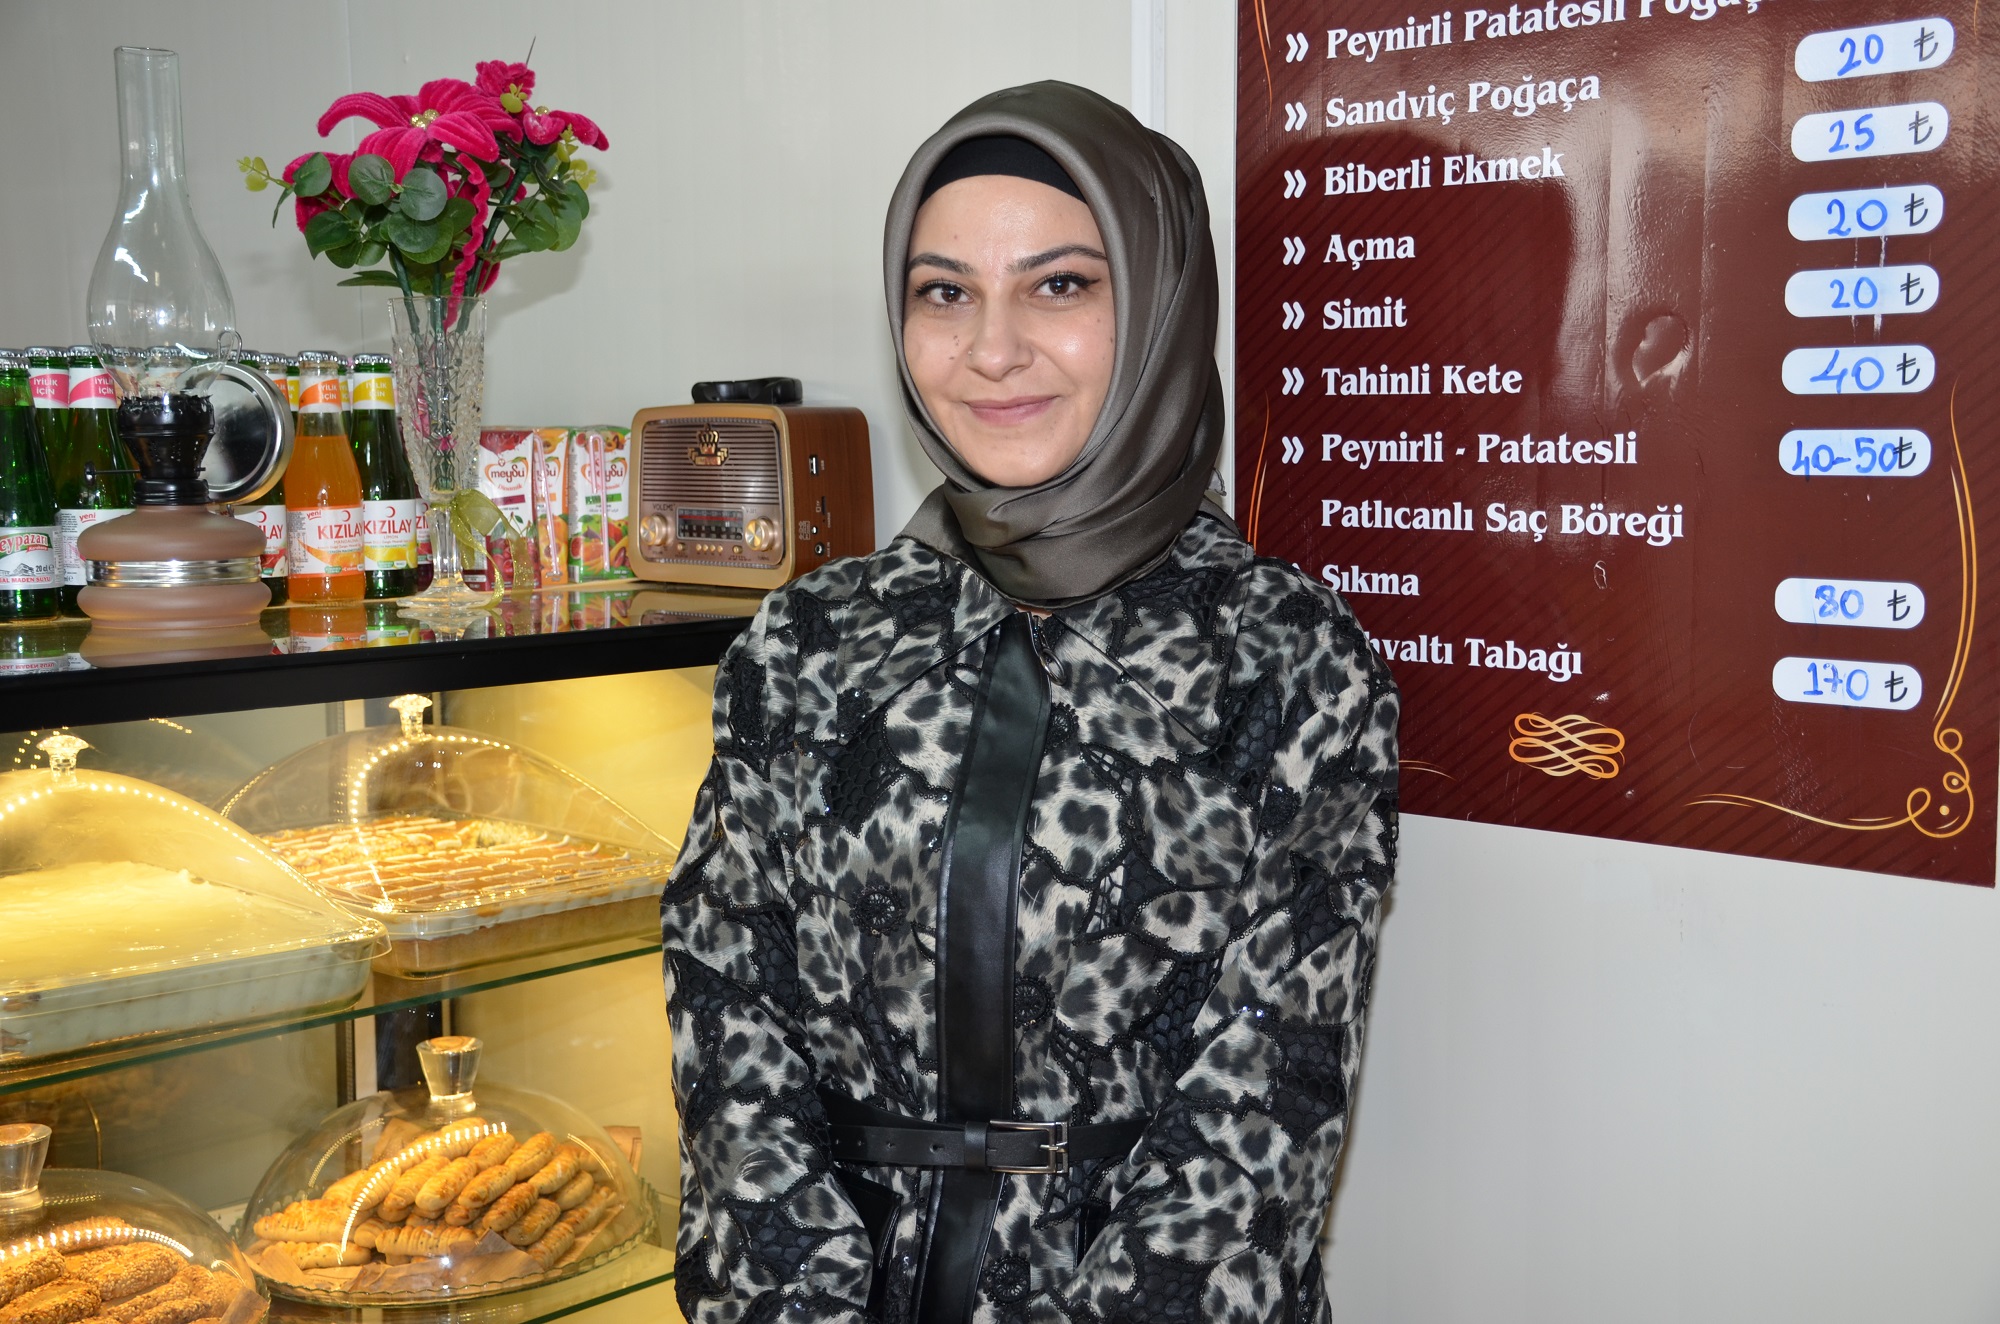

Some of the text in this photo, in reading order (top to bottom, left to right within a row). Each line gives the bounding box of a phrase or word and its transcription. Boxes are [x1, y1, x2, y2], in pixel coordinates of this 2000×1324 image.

[1327, 12, 1453, 62] Peynirli
[1464, 0, 1626, 41] Patatesli
[1837, 33, 1884, 77] 20
[1325, 75, 1601, 128] Sandviç Poğaça
[1828, 113, 1875, 153] 25
[1325, 147, 1565, 195] Biberli Ekmek
[1826, 198, 1888, 237] 20
[1324, 234, 1416, 271] Açma
[1829, 276, 1879, 309] 20
[1322, 296, 1408, 329] Simit
[1322, 364, 1523, 396] Tahinli Kete
[1809, 349, 1885, 395] 40
[36, 387, 55, 396] İÇİN
[1321, 432, 1444, 469] Peynirli
[1478, 431, 1638, 465] Patatesli
[79, 512, 96, 521] yeni
[306, 510, 322, 519] yeni
[363, 519, 412, 535] KIZILAY
[1321, 500, 1684, 546] Patlıcanlı Saç Böreği
[0, 534, 49, 554] eypazarı
[1321, 564, 1420, 597] Sıkma
[1464, 638, 1583, 683] Tabağı
[1803, 662, 1869, 701] 170
